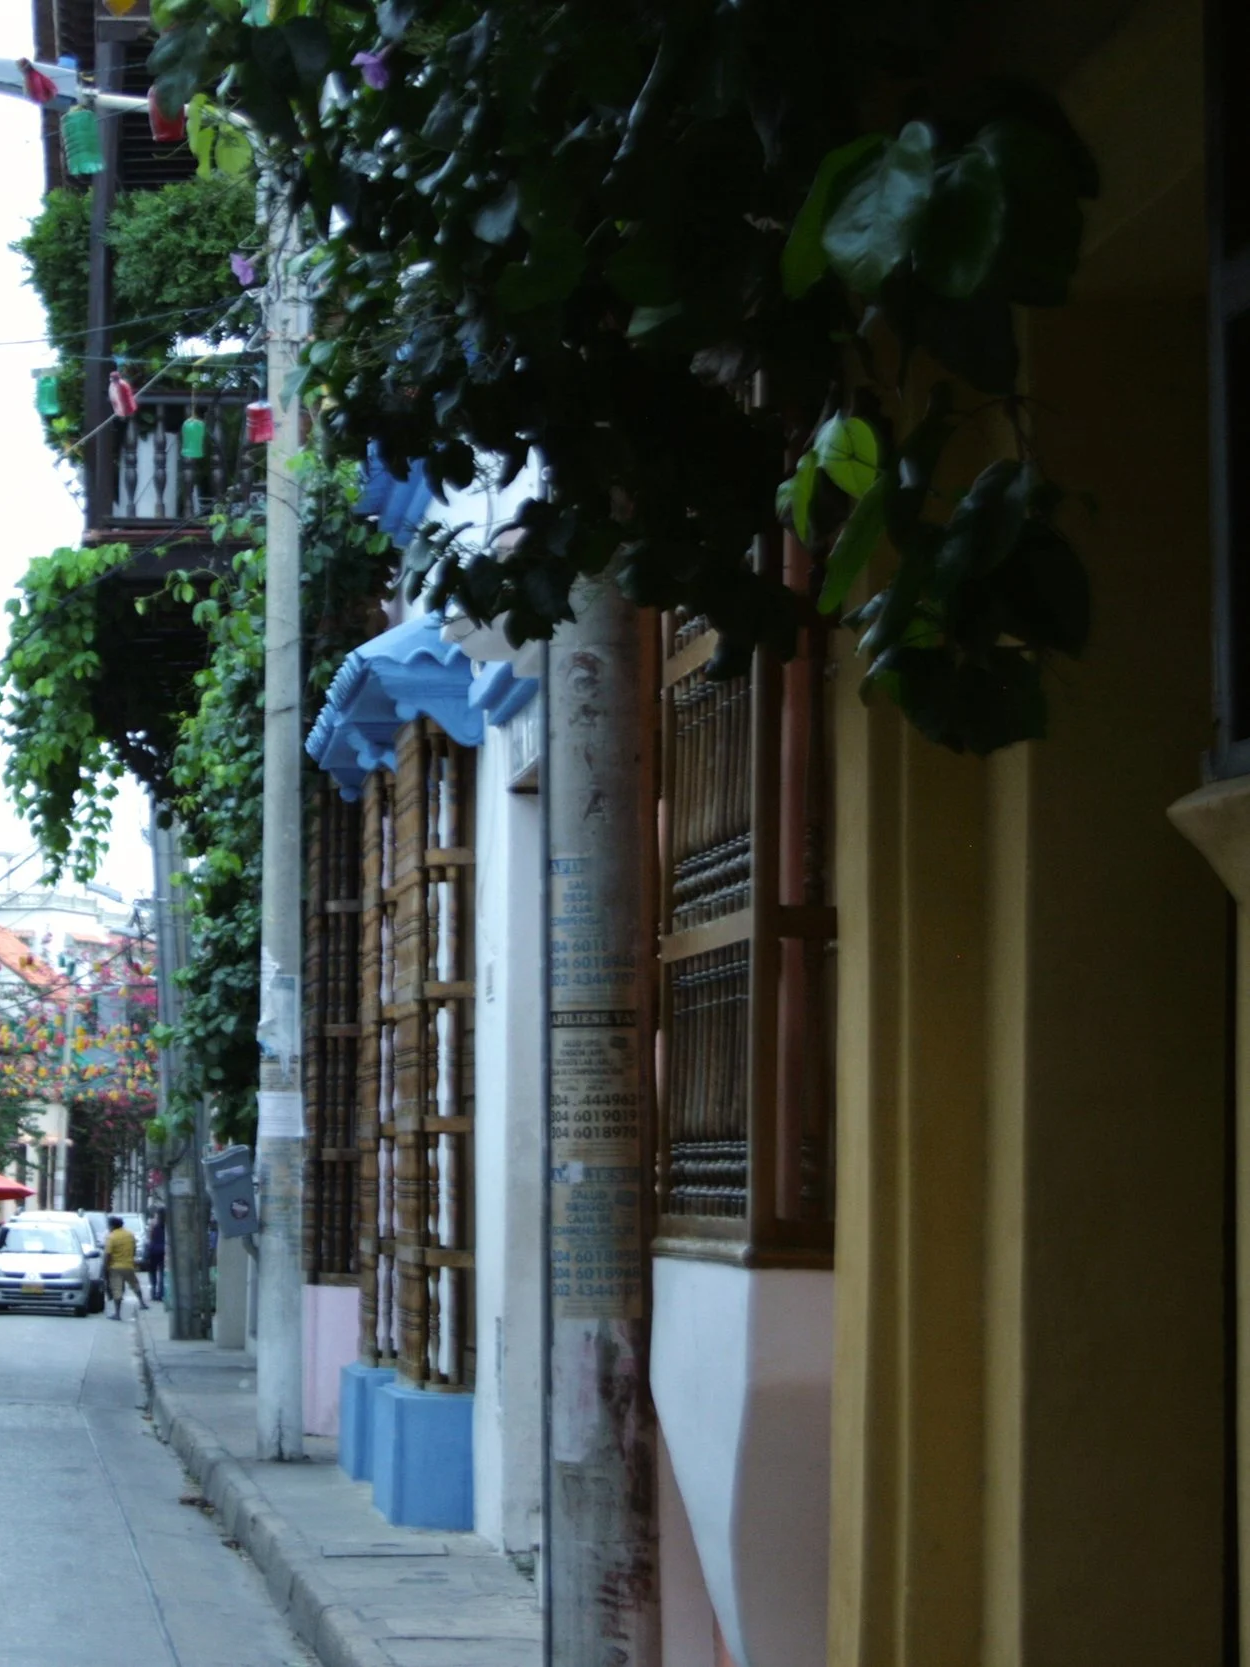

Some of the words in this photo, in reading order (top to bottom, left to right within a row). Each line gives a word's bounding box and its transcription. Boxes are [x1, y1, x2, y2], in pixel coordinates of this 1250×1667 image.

[574, 1093, 637, 1106] 444962
[573, 1109, 638, 1122] 6019019
[573, 1126, 638, 1139] 6018970
